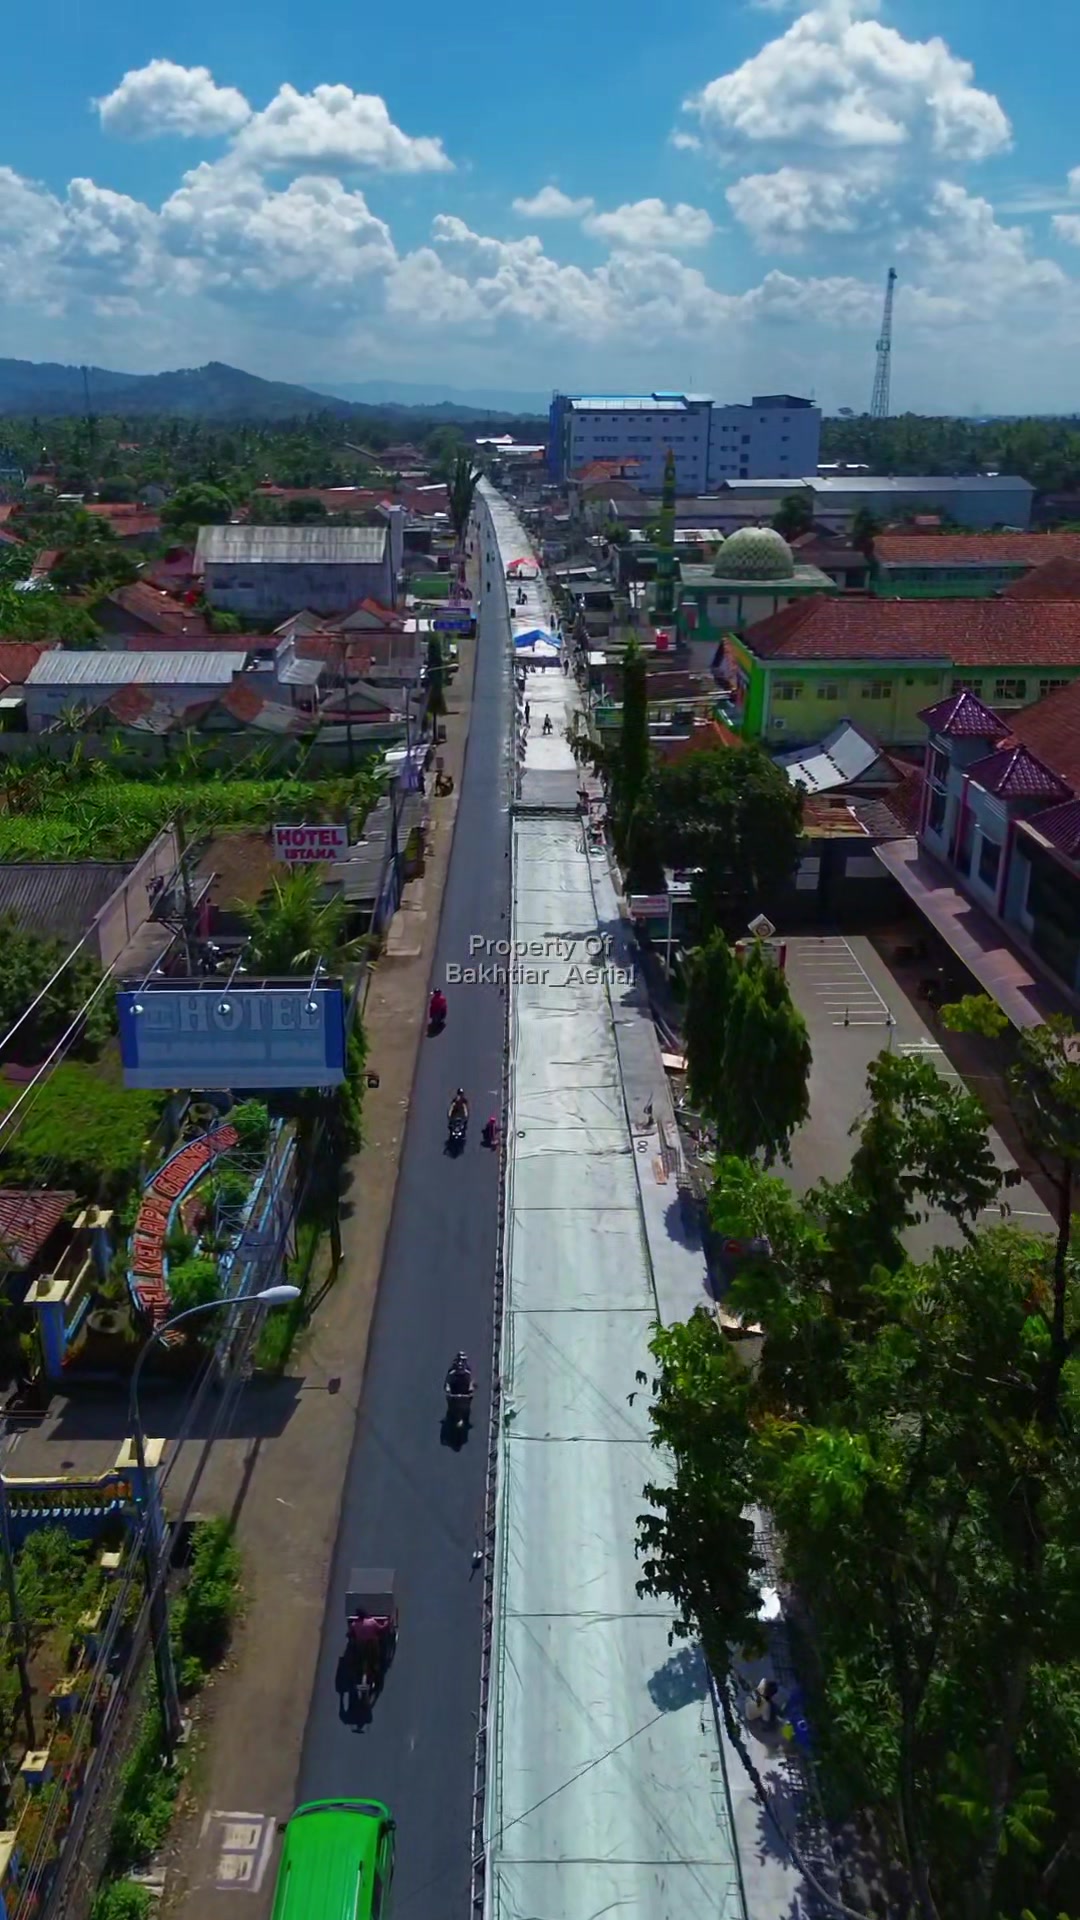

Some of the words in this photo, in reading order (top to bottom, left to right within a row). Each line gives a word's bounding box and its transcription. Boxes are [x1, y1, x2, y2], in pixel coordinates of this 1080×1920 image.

[277, 829, 344, 846] HOTEL
[179, 995, 320, 1031] HOTEL
[134, 1198, 171, 1276] KELAPA
